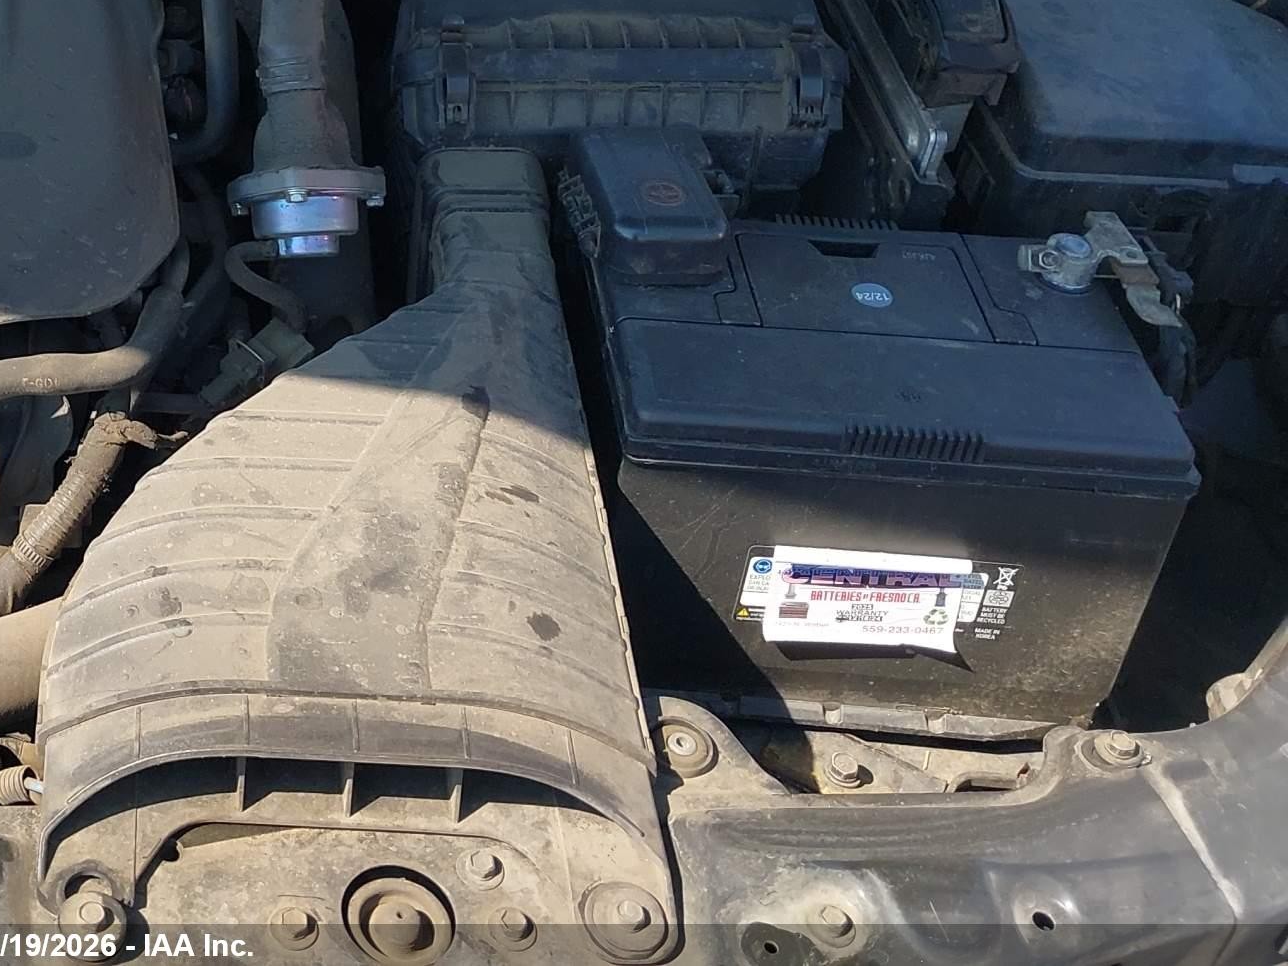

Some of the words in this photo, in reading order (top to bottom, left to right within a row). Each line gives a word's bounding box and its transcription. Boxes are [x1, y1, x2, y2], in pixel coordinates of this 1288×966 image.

[781, 563, 963, 589] CENTRAL
[810, 590, 862, 602] BATTERIES
[869, 592, 906, 603] FRESNO
